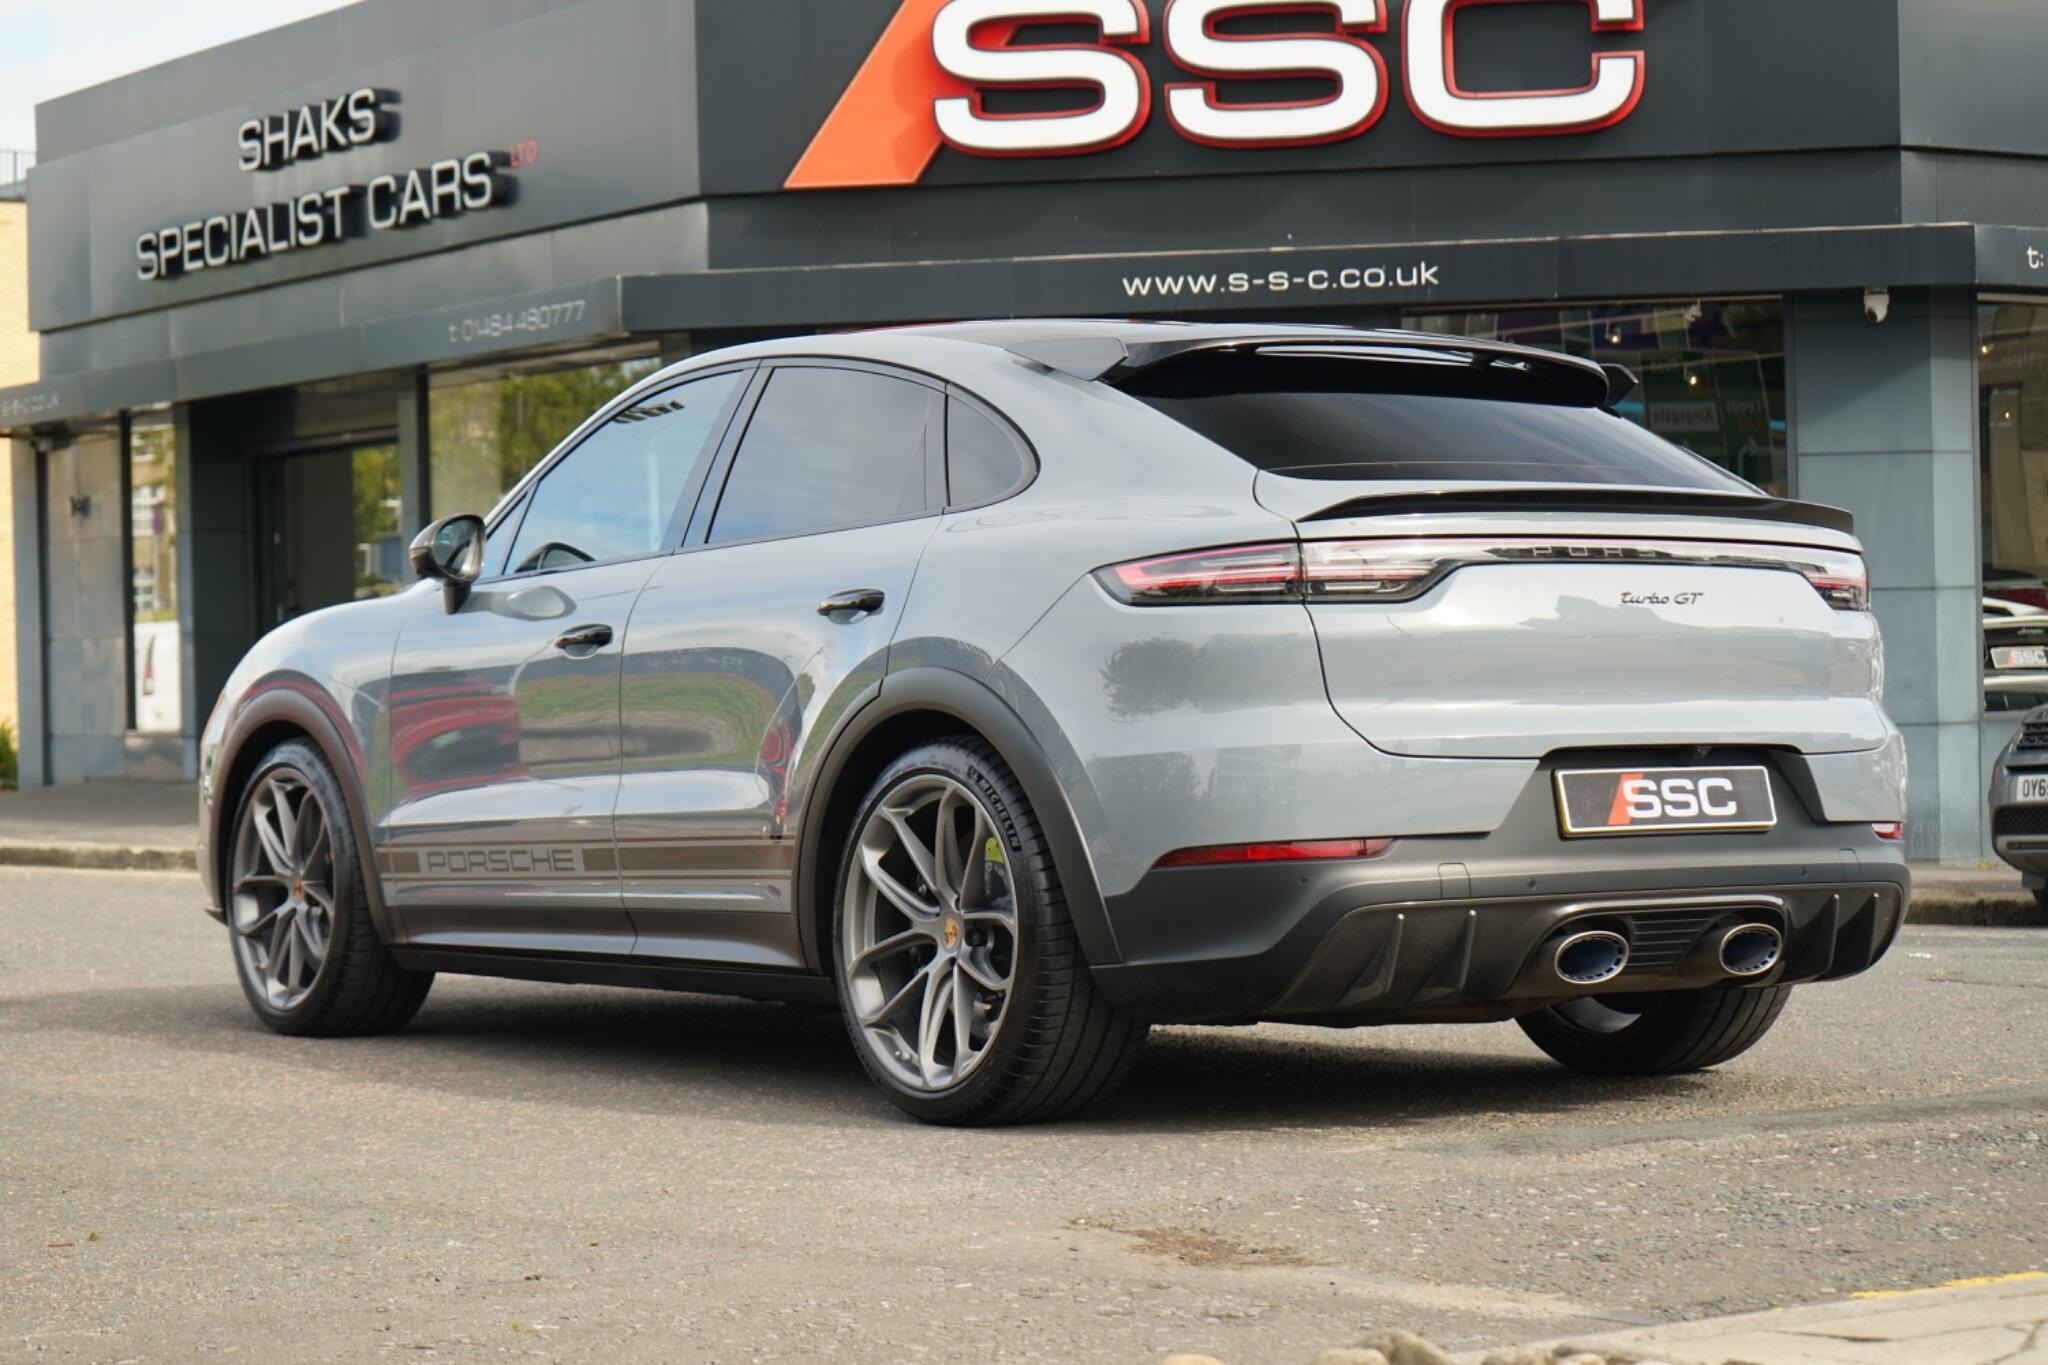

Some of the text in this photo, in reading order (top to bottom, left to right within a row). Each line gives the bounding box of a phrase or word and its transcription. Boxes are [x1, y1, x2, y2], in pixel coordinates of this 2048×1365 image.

[931, 0, 1646, 157] SSC
[237, 88, 377, 172] SHAKS
[510, 140, 539, 169] LTD
[135, 151, 494, 281] SPECIALIST CARS
[1121, 260, 1440, 297] www.s-s-c.co.uk
[1673, 591, 1704, 605] GT
[1621, 777, 1738, 819] SSC
[426, 849, 576, 873] PORSCHE
